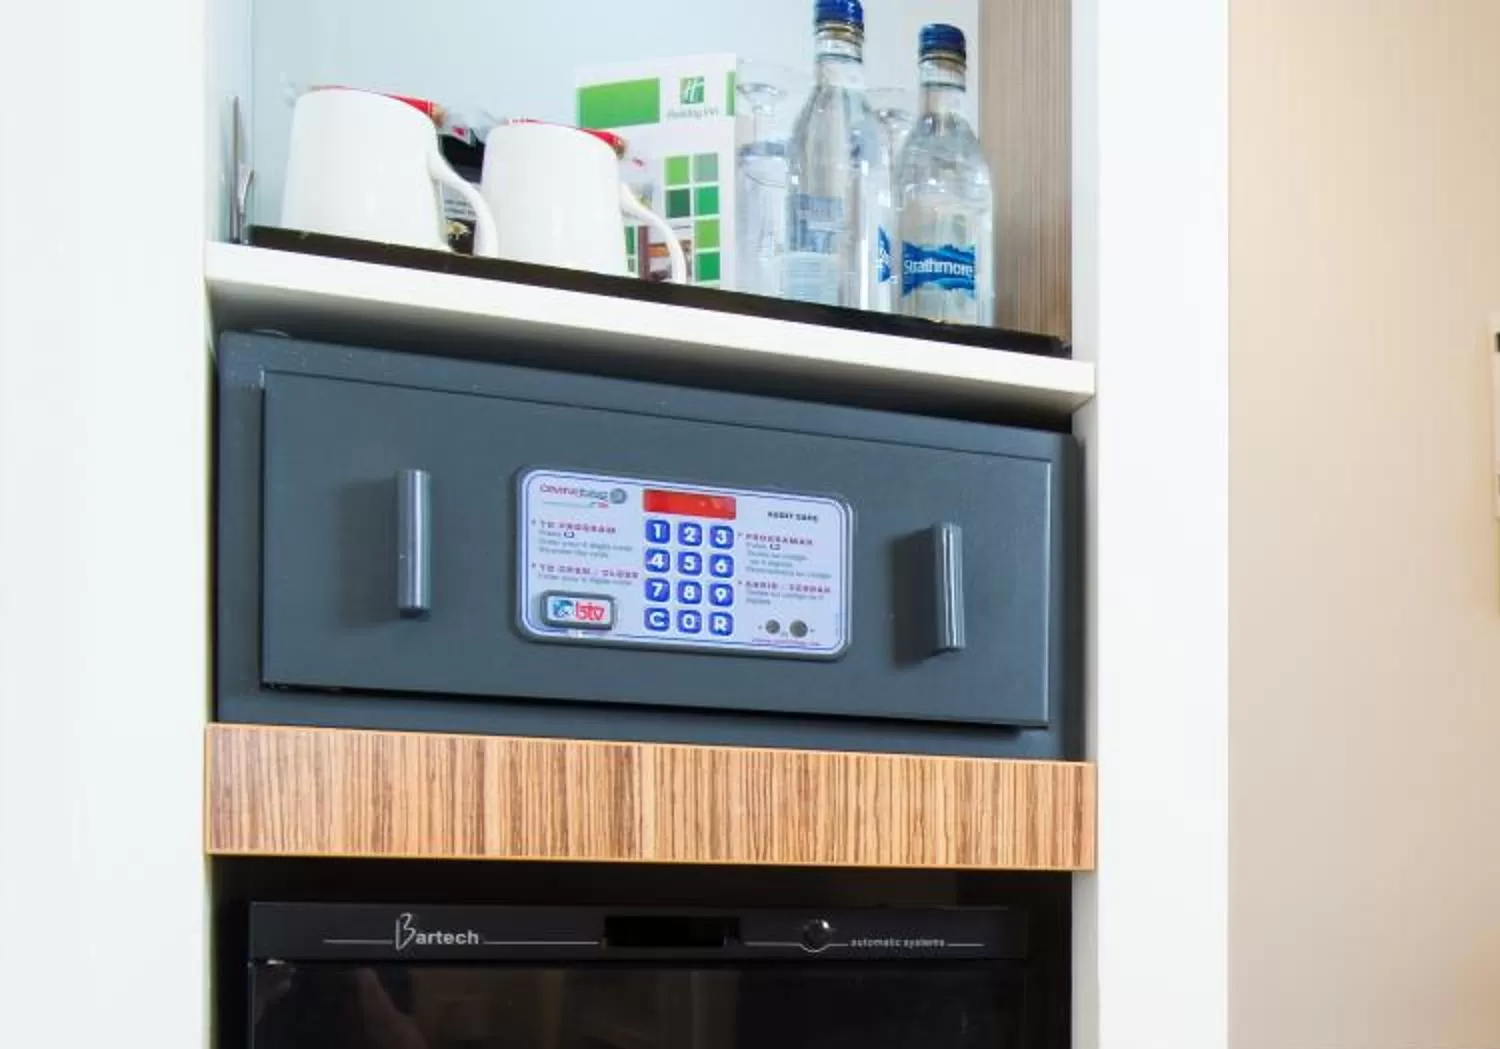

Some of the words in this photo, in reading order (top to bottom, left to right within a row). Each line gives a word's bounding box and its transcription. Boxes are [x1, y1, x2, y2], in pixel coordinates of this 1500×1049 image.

[903, 257, 974, 278] Strathmore
[653, 523, 663, 540] 1
[684, 526, 696, 543] 2
[715, 529, 728, 545] 3
[648, 553, 664, 569] 4
[684, 555, 696, 572] 5
[715, 558, 728, 574] 6
[651, 582, 664, 598] 7
[684, 584, 696, 601] 8
[715, 587, 728, 603] 9
[650, 611, 665, 628] C
[714, 616, 727, 632] R
[395, 912, 480, 951] Bartech
[851, 935, 900, 949] automatic
[904, 936, 945, 950] systems
